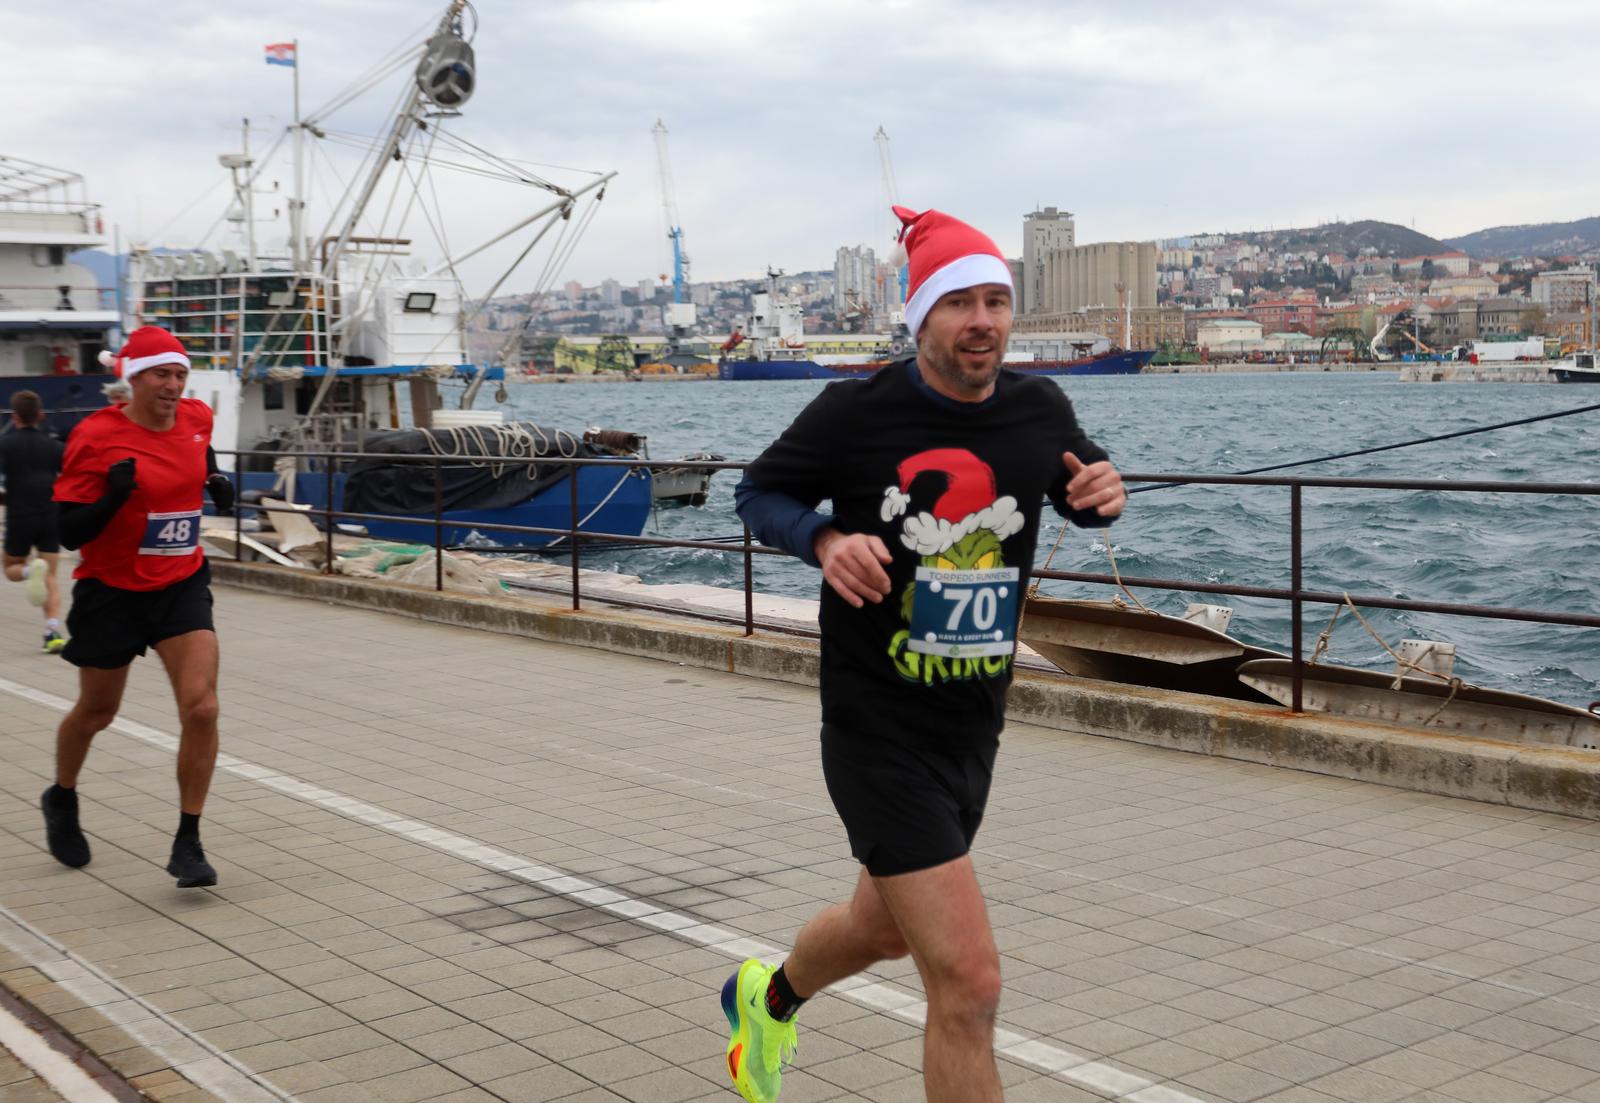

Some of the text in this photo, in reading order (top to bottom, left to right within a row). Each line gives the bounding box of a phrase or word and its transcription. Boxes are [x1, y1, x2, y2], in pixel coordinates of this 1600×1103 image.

[157, 519, 192, 542] 48
[929, 571, 1012, 582] TORPEDO RUNNERS
[943, 587, 997, 631] 70
[938, 633, 956, 641] HAVE
[957, 633, 963, 641] A
